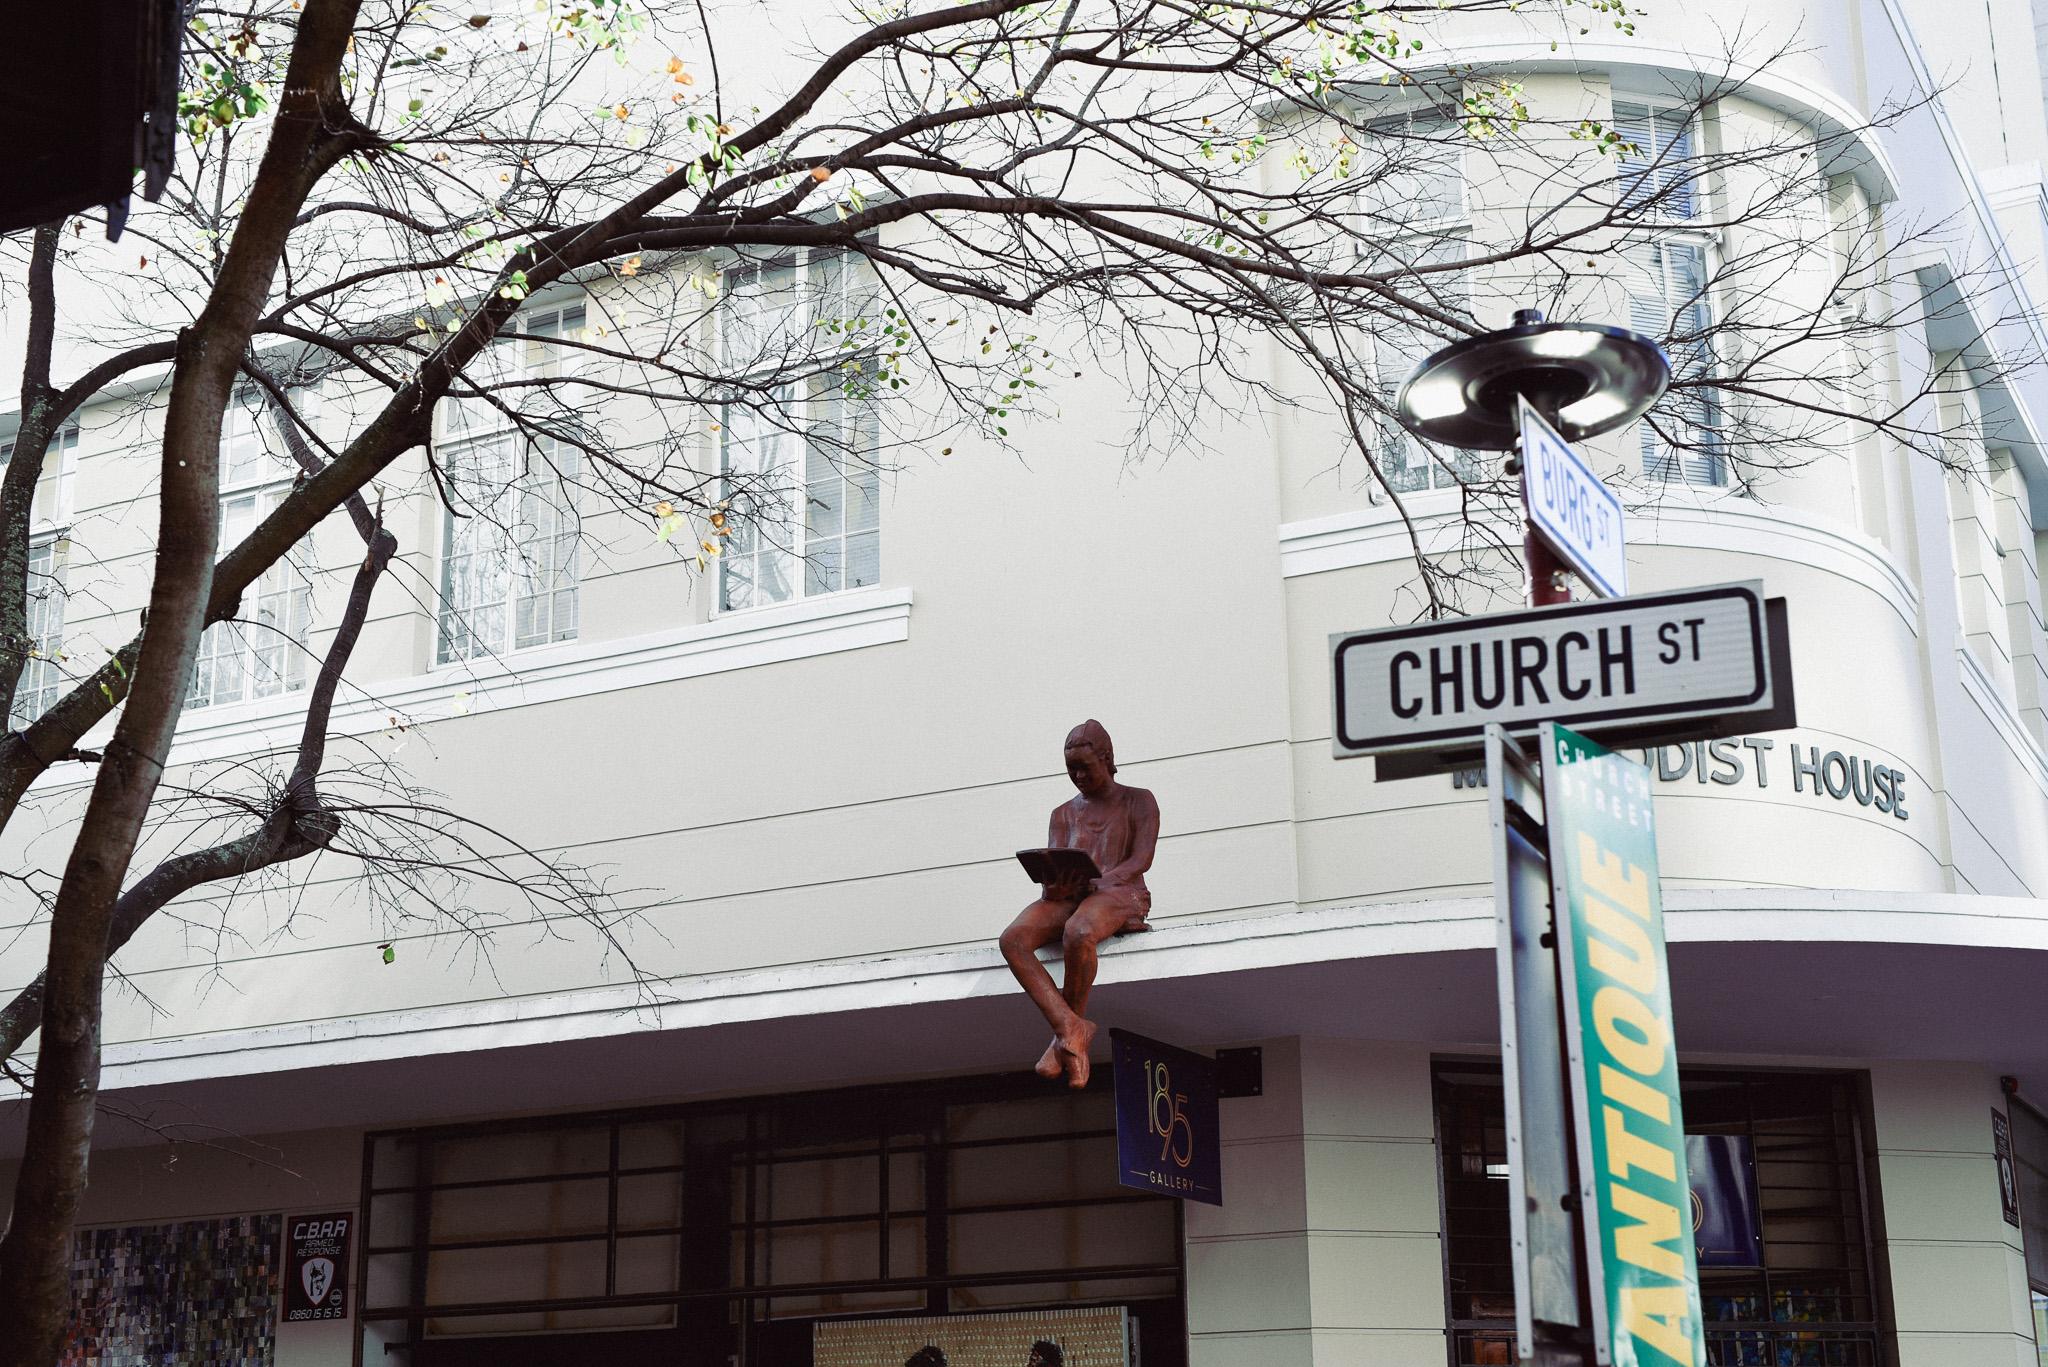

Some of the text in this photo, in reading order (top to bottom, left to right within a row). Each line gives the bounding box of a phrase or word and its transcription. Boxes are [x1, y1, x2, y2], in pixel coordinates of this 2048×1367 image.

[1541, 441, 1611, 551] BURG ST
[1390, 618, 1705, 720] CHURCH ST
[1558, 739, 1649, 800] CHURCH
[1791, 743, 1908, 821] HOUSE
[1561, 771, 1652, 832] STREET
[1144, 1059, 1193, 1168] 1895
[1577, 831, 1694, 1367] ANTIQUE
[1150, 1170, 1195, 1192] GALLERY
[296, 1246, 342, 1257] RESPONSE
[305, 1238, 334, 1248] ARMED
[289, 1307, 342, 1320] 0860 15 15 15
